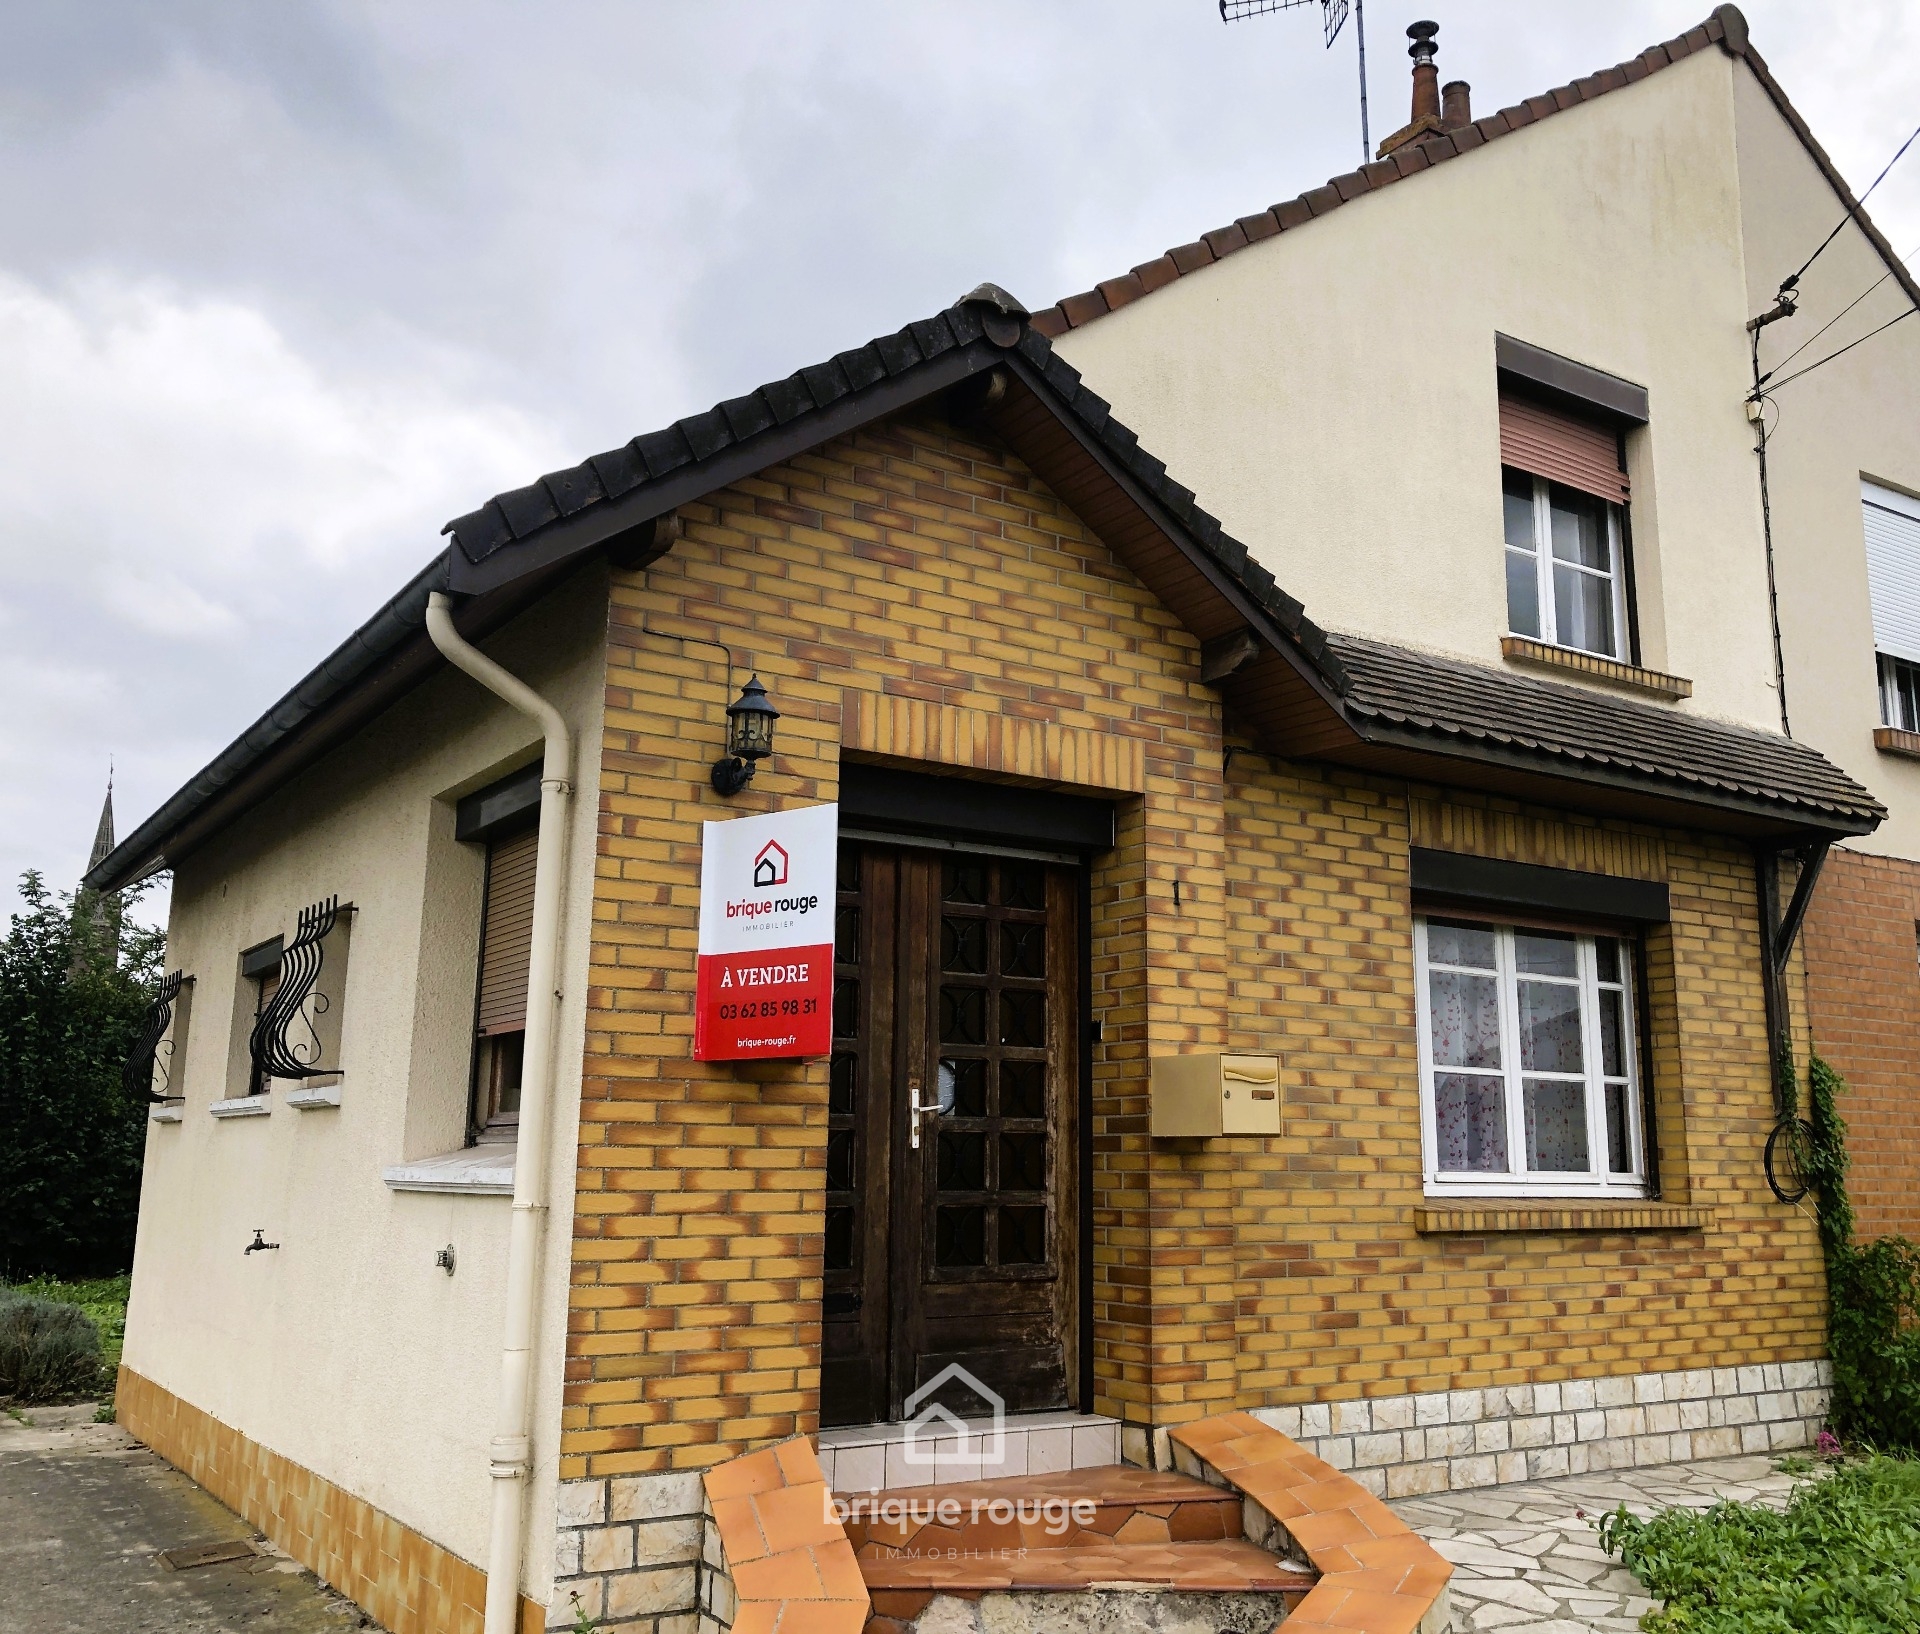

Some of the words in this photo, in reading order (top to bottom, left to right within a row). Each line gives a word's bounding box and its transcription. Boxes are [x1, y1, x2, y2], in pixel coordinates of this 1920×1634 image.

[726, 898, 772, 919] brique
[774, 895, 818, 915] rouge
[742, 920, 794, 932] IMMOBILIER
[720, 966, 733, 988] À
[736, 963, 809, 987] VENDRE
[720, 1004, 737, 1020] 03
[740, 1002, 757, 1018] 62
[760, 1001, 778, 1017] 85
[781, 999, 799, 1015] 98
[802, 998, 817, 1014] 31
[737, 1034, 796, 1049] brique-rouge.fr
